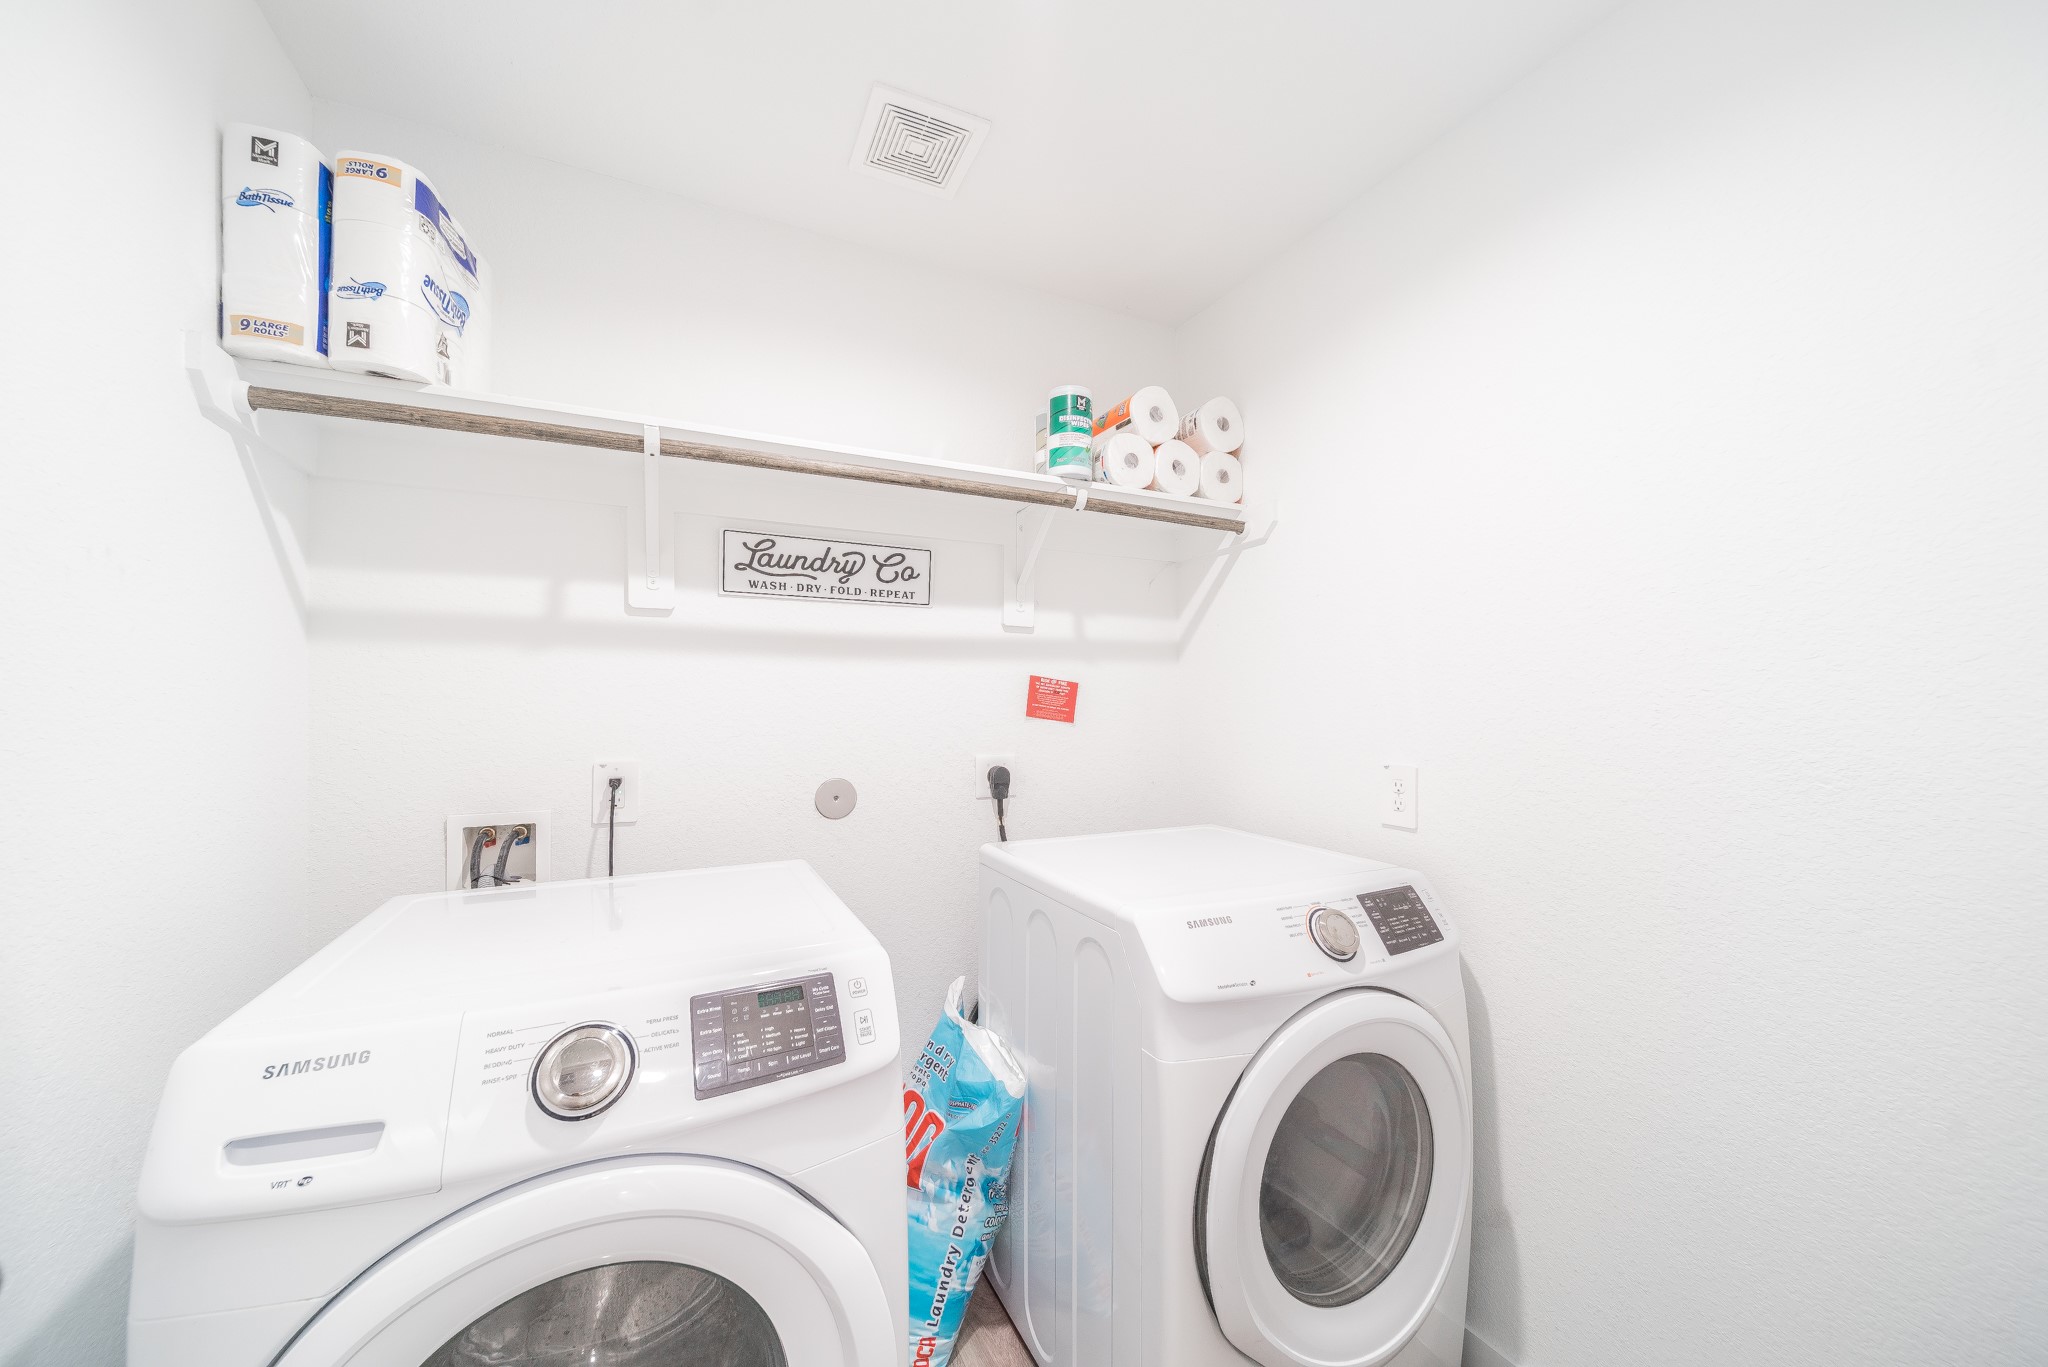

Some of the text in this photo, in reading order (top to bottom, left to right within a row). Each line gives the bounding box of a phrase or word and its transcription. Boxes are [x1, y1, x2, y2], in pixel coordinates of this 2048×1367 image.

[348, 160, 374, 170] ROLLS
[344, 166, 388, 179] 9 LARGE
[240, 318, 290, 332] 9 LARGE
[253, 326, 286, 337] ROLLS
[734, 538, 920, 584] Laundry Co
[748, 579, 916, 600] WASH DRY FOLD REPEAT
[1186, 915, 1233, 930] SAMSUNG
[663, 1014, 679, 1022] PRESS
[486, 1029, 514, 1039] NORMAL
[650, 1029, 680, 1038] DELICATES
[485, 1043, 525, 1054] HEAVY DUTY
[644, 1044, 663, 1053] ACTIVE
[262, 1050, 371, 1080] SAMSUNG
[483, 1059, 513, 1070] BEDDING
[926, 1242, 962, 1329] Laundry
[951, 1153, 981, 1239] Detergent
